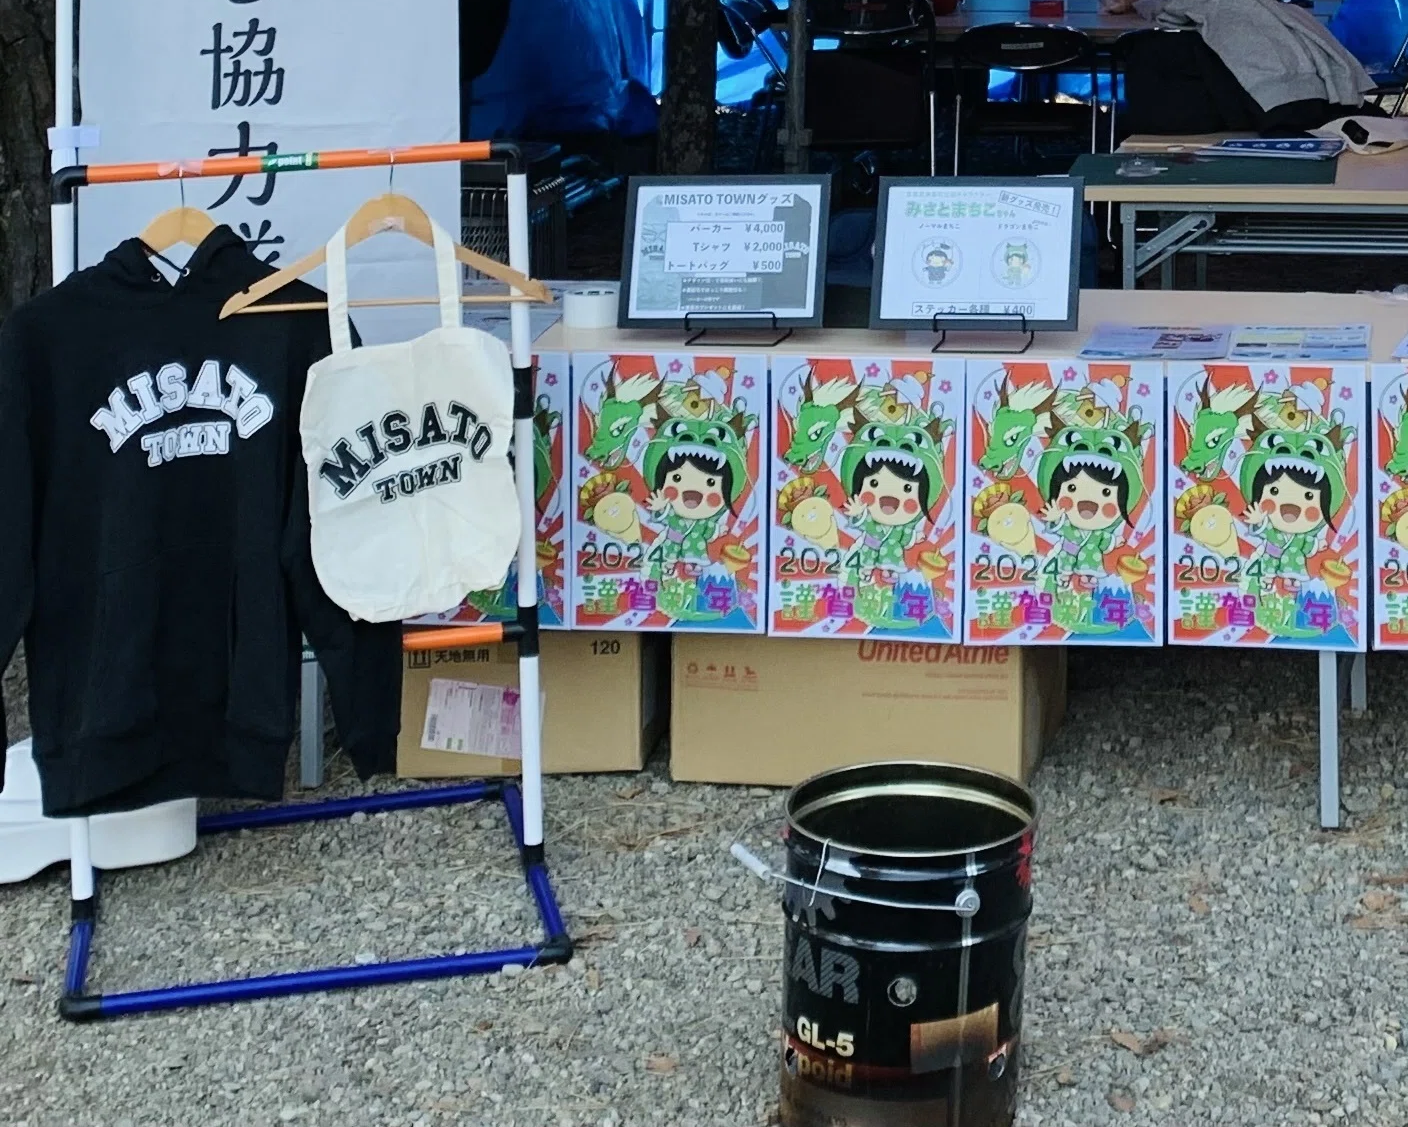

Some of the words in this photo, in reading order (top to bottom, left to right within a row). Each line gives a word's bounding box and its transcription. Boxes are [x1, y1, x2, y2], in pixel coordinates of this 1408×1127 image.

[664, 193, 713, 205] MISATO
[89, 359, 274, 454] MISATO
[141, 421, 231, 467] TOWN
[319, 400, 493, 500] MISATO
[375, 453, 462, 504] TOWN
[582, 542, 665, 568] 2024
[779, 547, 864, 574] 2024
[974, 554, 1061, 581] 2024
[1178, 555, 1265, 582] 2024
[582, 573, 733, 616] 謹賀新年
[779, 579, 931, 623] 謹賀新年
[974, 585, 1132, 631] 謹賀新年
[1179, 587, 1333, 632] 謹賀新年
[434, 649, 490, 664] 天地無用
[590, 639, 620, 655] 120
[797, 1015, 855, 1057] GL-5
